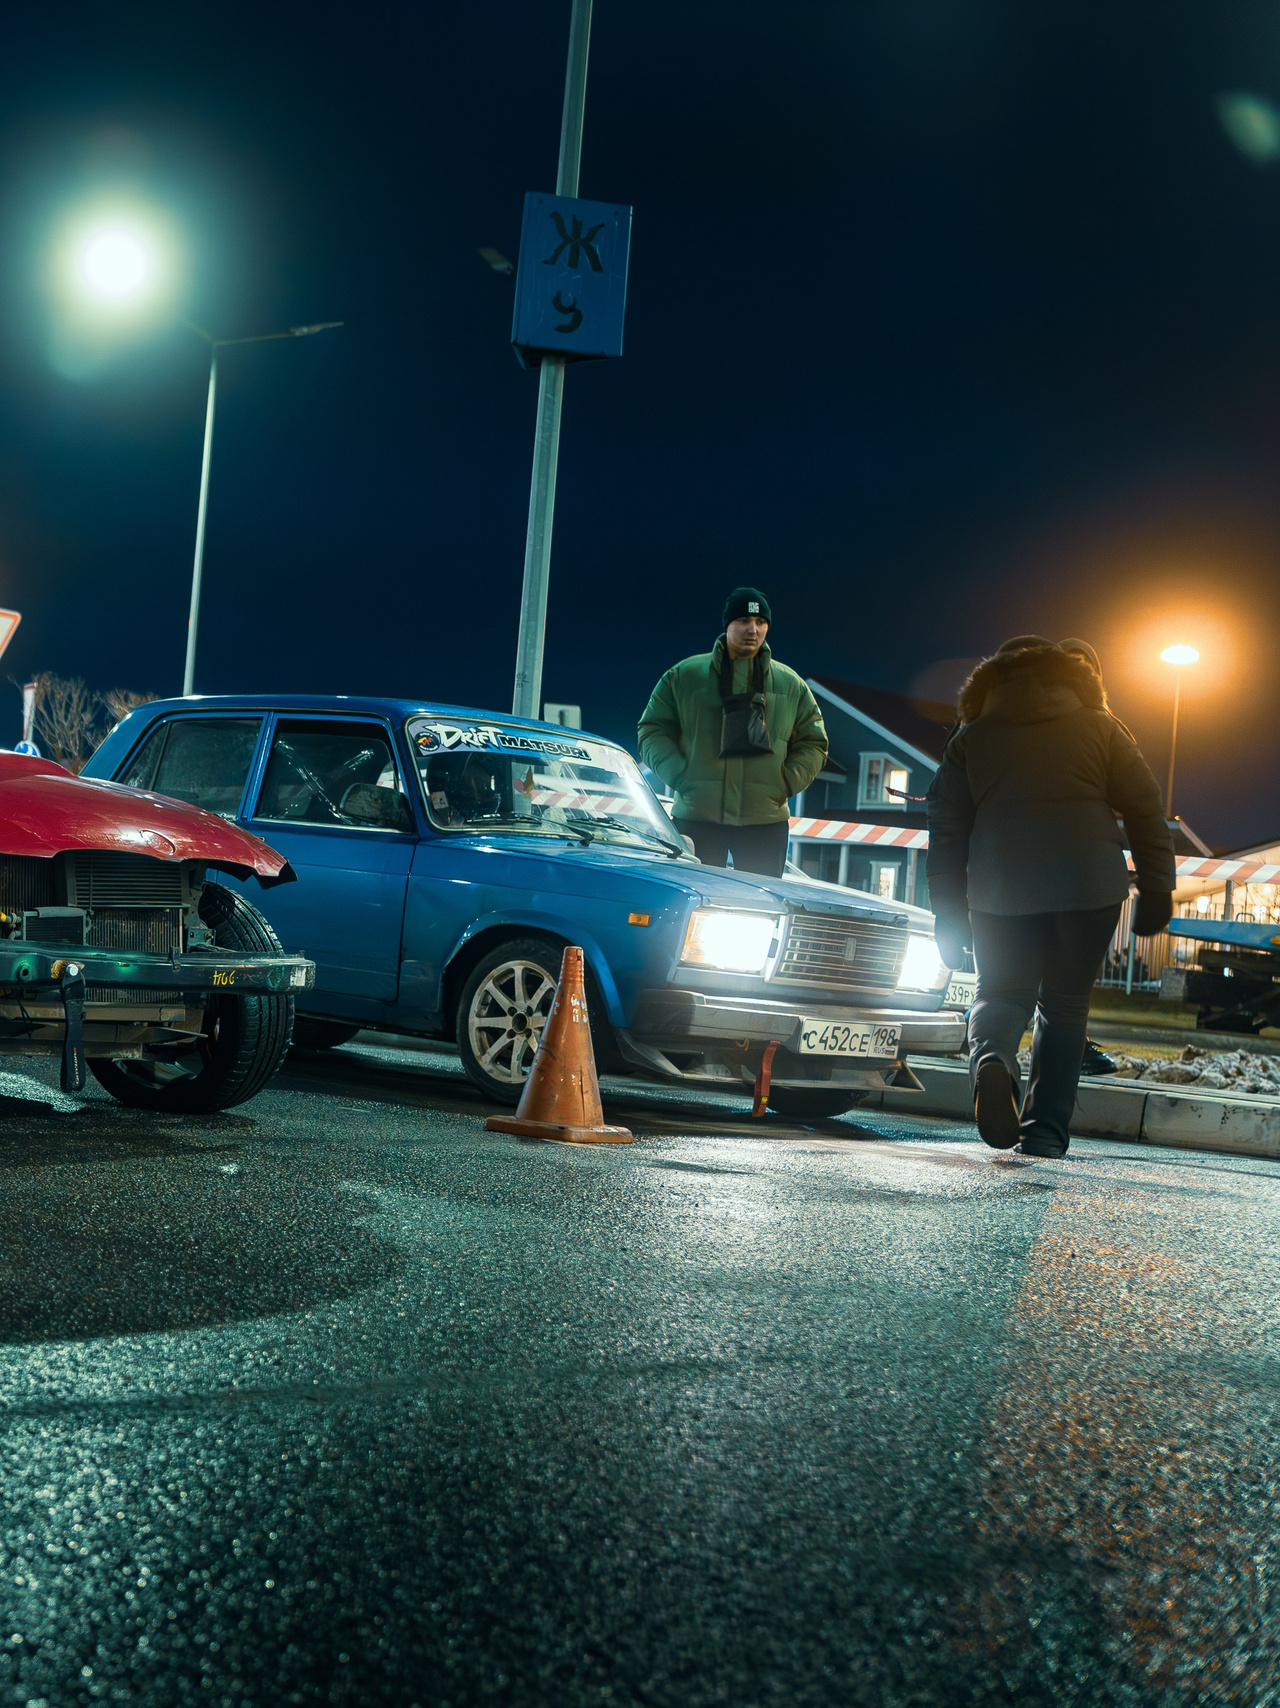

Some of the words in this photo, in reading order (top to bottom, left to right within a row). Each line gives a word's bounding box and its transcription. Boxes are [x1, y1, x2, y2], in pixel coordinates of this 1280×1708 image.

[542, 211, 605, 273] Ж
[498, 735, 592, 761] MATSURI
[873, 1027, 895, 1047] 198
